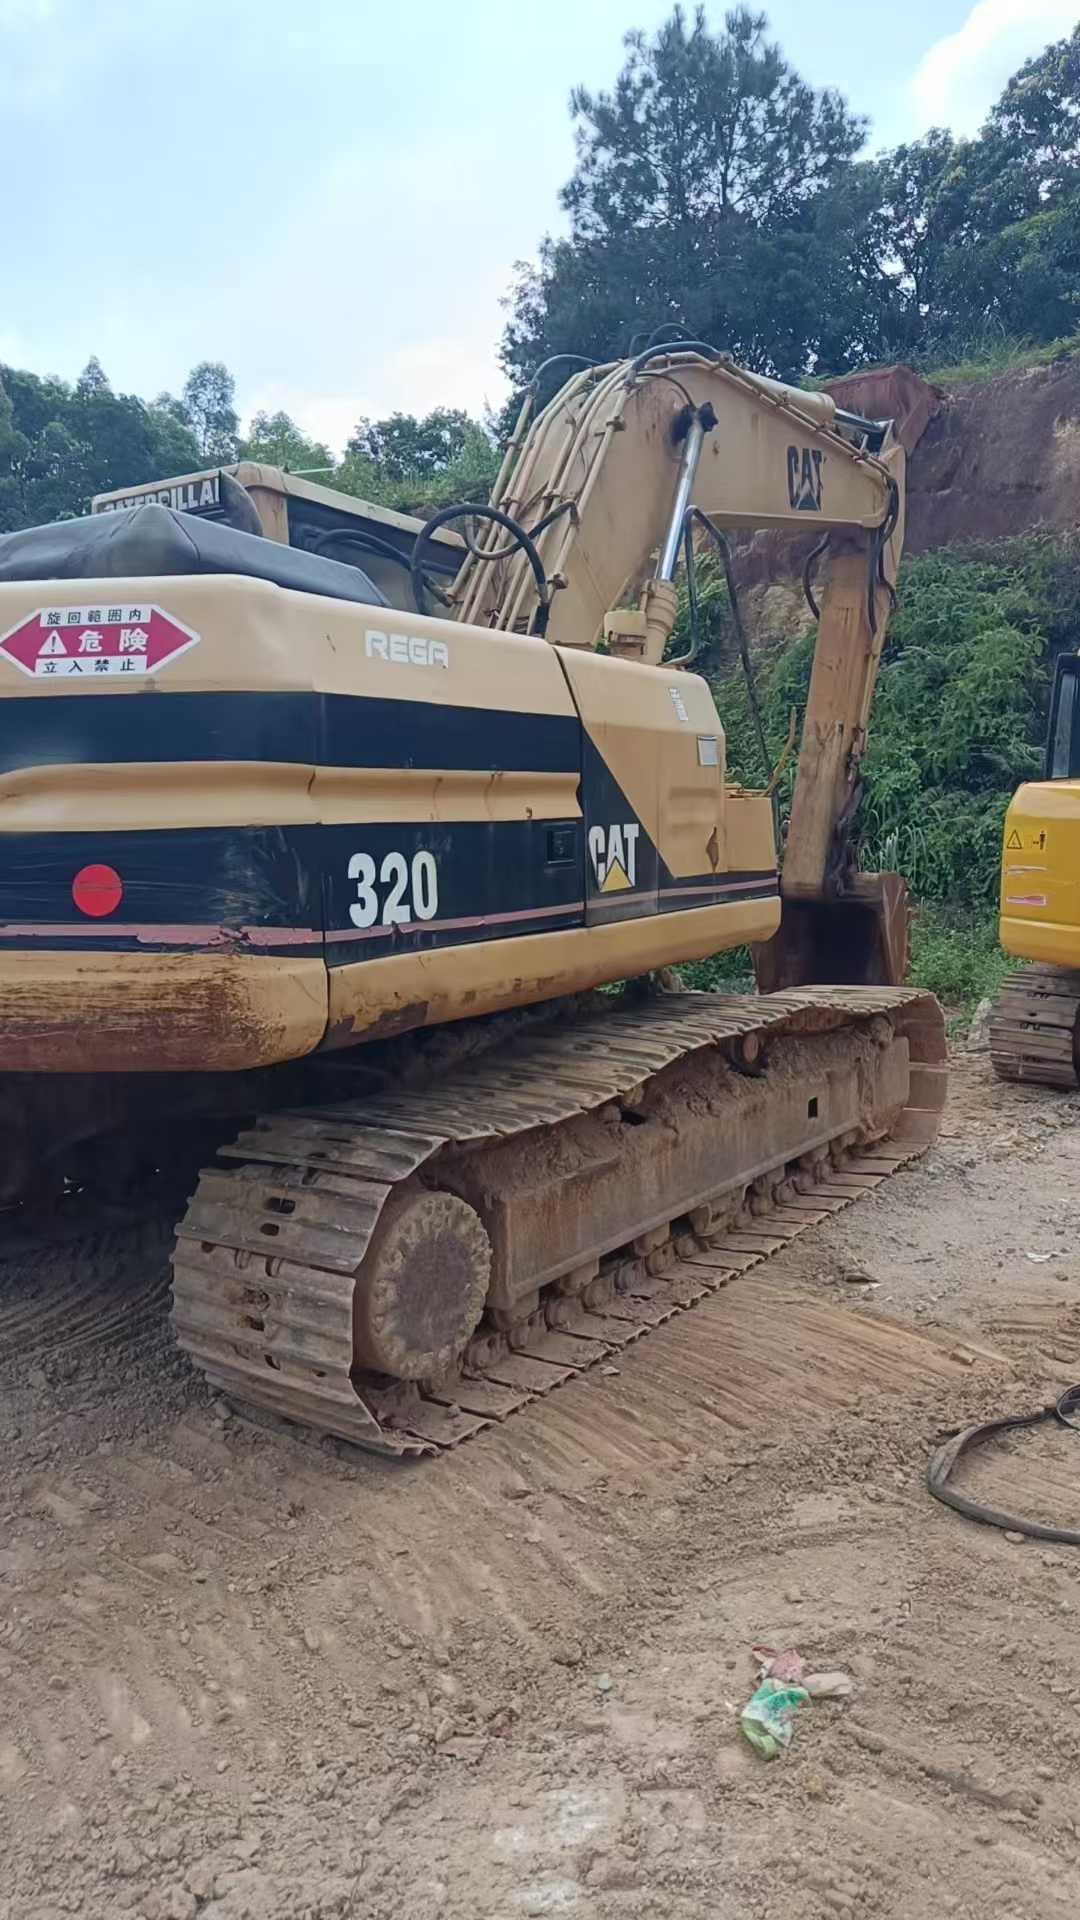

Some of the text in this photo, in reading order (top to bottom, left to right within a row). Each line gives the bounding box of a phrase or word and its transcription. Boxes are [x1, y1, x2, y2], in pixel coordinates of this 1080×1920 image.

[787, 446, 822, 511] CAT
[47, 608, 142, 625] 旋回範囲内
[78, 627, 149, 653] 危険
[365, 630, 449, 669] REGA
[42, 658, 136, 674] 立入禁止
[588, 823, 640, 892] CAT
[347, 850, 438, 928] 320
